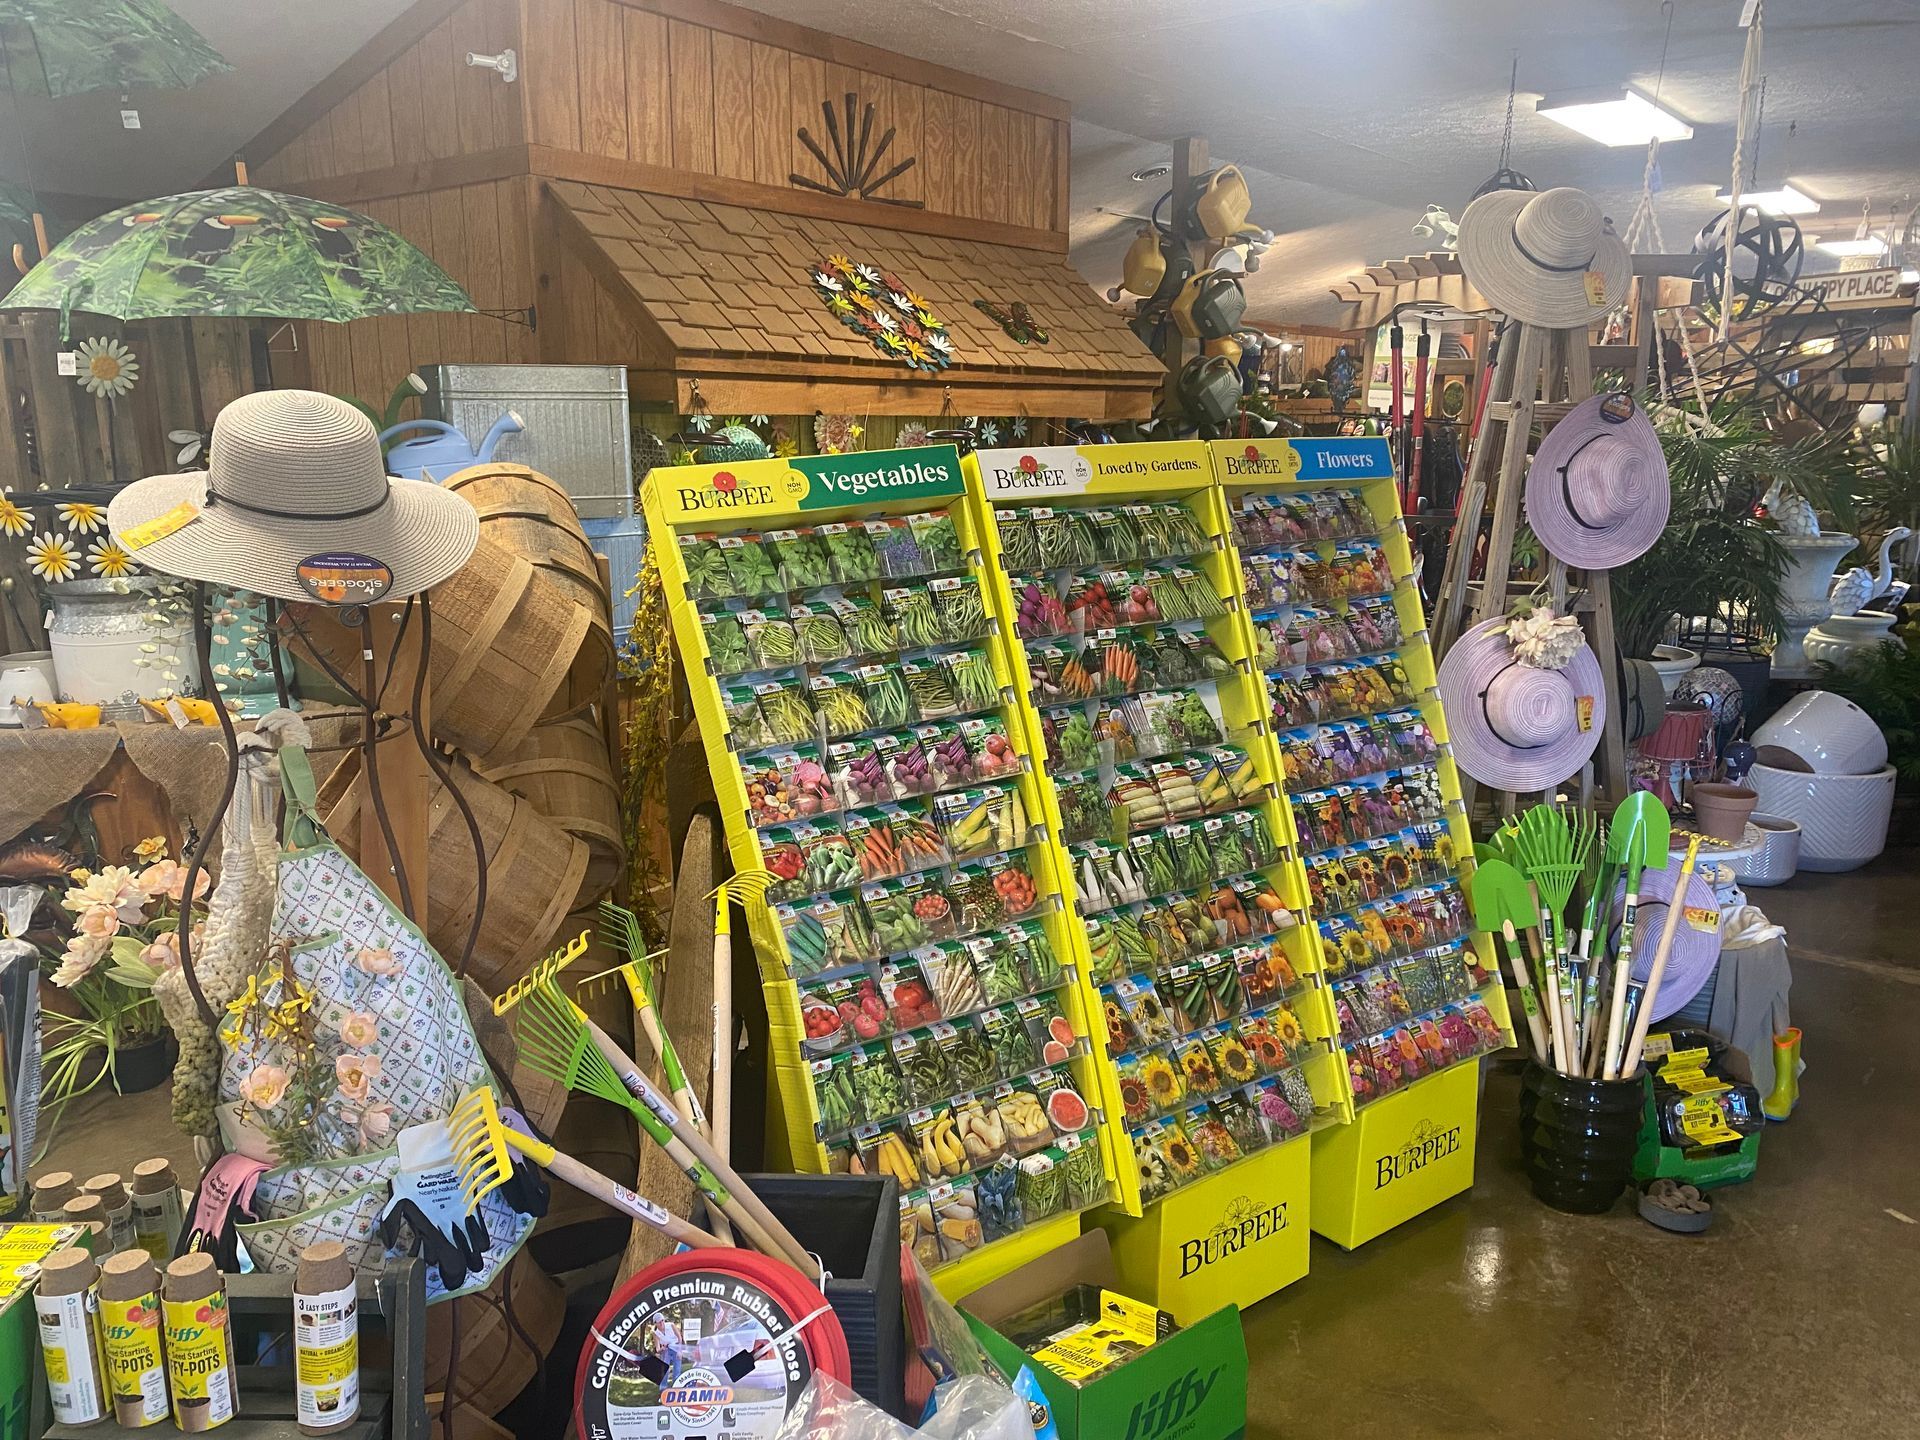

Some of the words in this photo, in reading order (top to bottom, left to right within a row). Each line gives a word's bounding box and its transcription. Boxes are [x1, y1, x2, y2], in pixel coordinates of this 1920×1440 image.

[1847, 274, 1894, 297] PLACE
[1098, 462, 1133, 475] Loved
[1135, 461, 1149, 476] by
[1152, 458, 1202, 472] Gardens.
[1227, 455, 1281, 475] BURPEE
[1317, 450, 1374, 469] Flowers
[787, 481, 801, 489] NON
[816, 462, 949, 495] Vegetables
[993, 469, 1067, 489] BURPEE
[677, 485, 773, 511] BURPEE
[309, 577, 383, 588] SLOGGERS
[1375, 1126, 1462, 1191] BURPEE
[17, 1242, 52, 1250] PELLETS
[1179, 1202, 1289, 1279] BURPEE
[299, 1299, 304, 1310] 3
[306, 1304, 319, 1312] EASY
[321, 1302, 338, 1311] STEPS
[653, 1279, 726, 1305] Premium
[731, 1285, 784, 1334] Rubber
[780, 1335, 801, 1382] Hose
[120, 1346, 150, 1358] Starting
[172, 1352, 186, 1360] Seed
[188, 1346, 217, 1359] Starting
[300, 1349, 318, 1357] NATURAL
[324, 1346, 344, 1356] ORGANIC
[1046, 1345, 1103, 1369] GREENHOUSE
[1078, 1346, 1097, 1354] KIT
[679, 1372, 694, 1384] Made
[703, 1372, 714, 1383] USA
[666, 1389, 728, 1403] DRAMM
[675, 1408, 691, 1424] Quality
